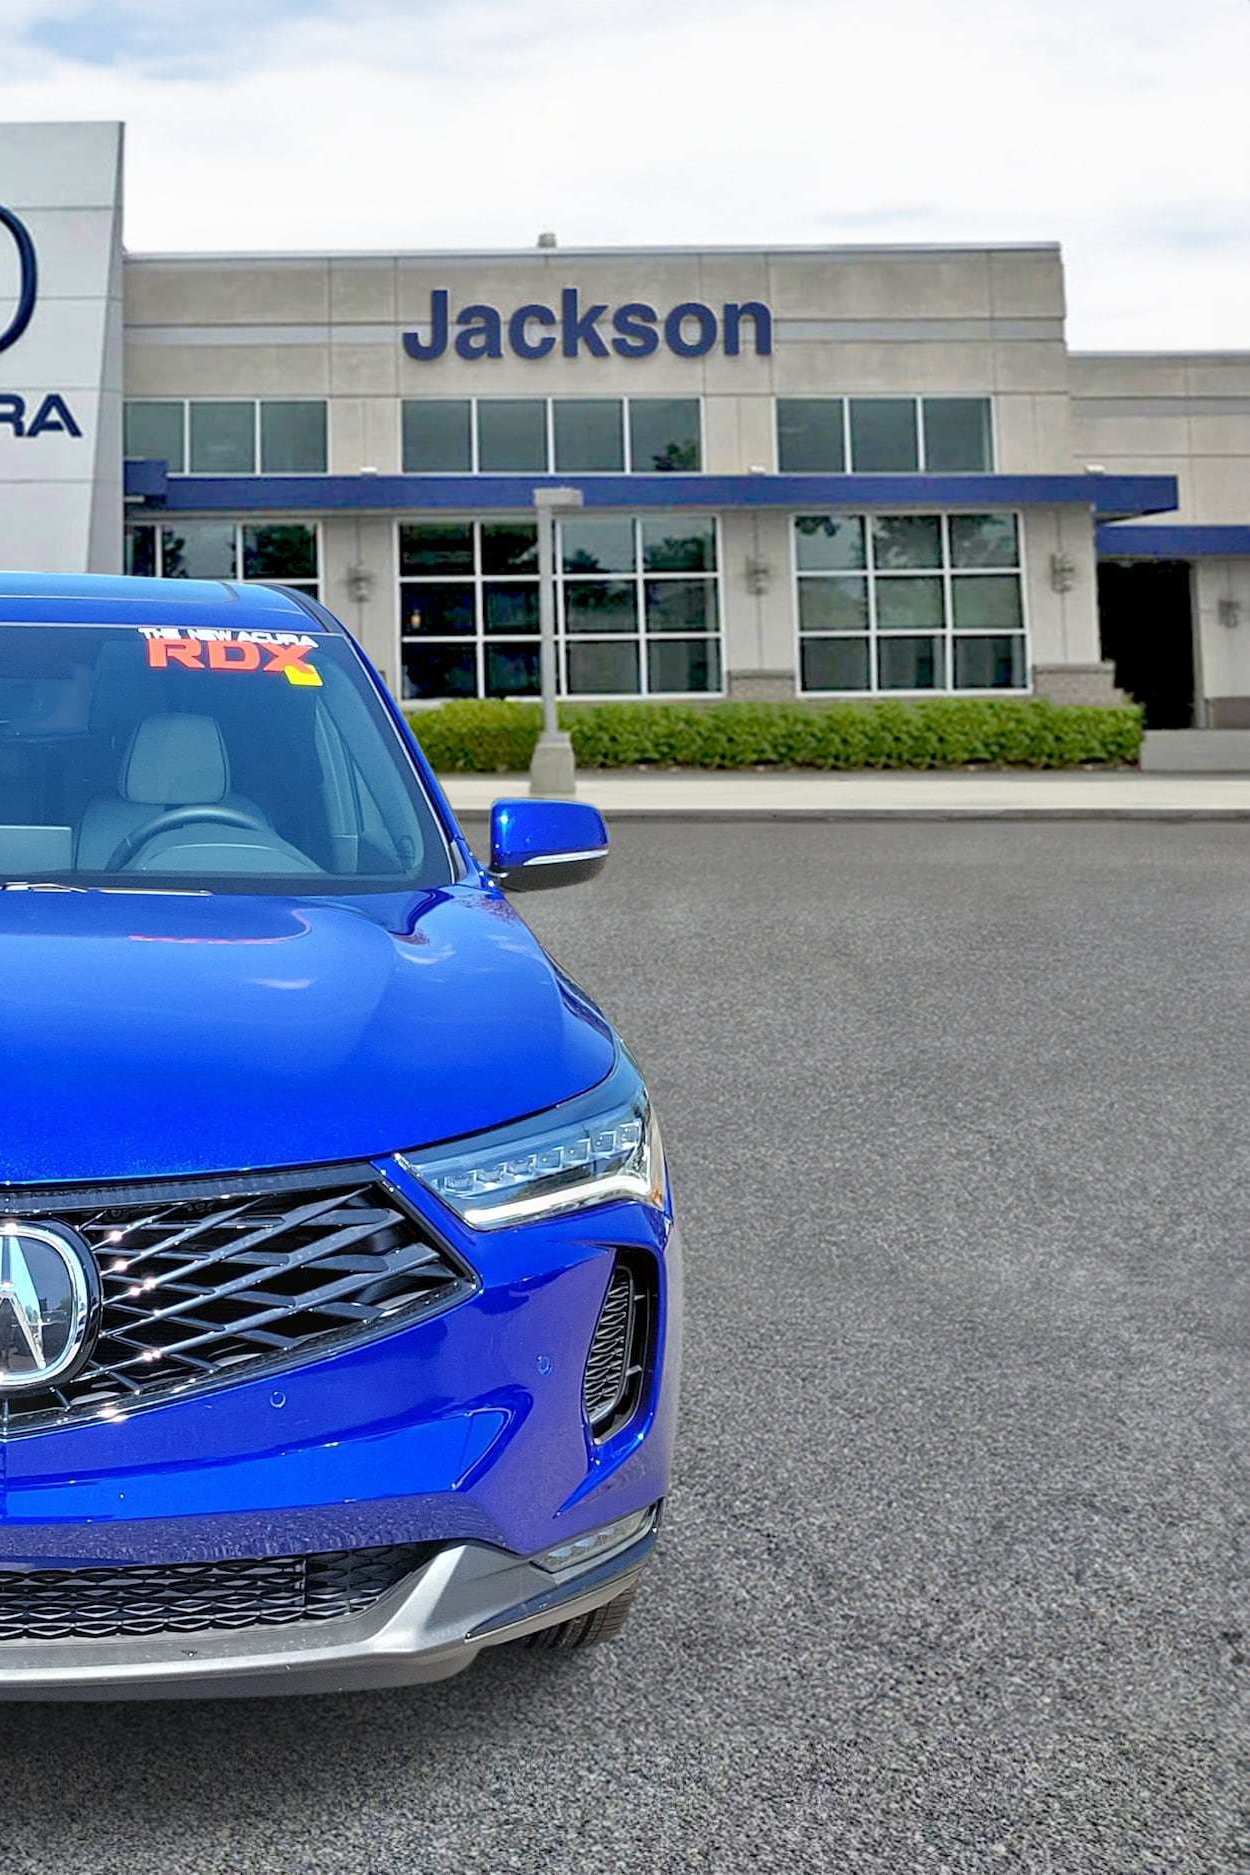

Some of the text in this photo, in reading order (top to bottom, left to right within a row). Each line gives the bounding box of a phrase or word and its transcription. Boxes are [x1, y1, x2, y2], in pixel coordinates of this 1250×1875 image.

[402, 288, 773, 361] Jackson
[137, 627, 319, 649] THE NEW ACURA
[147, 637, 316, 673] RDX
